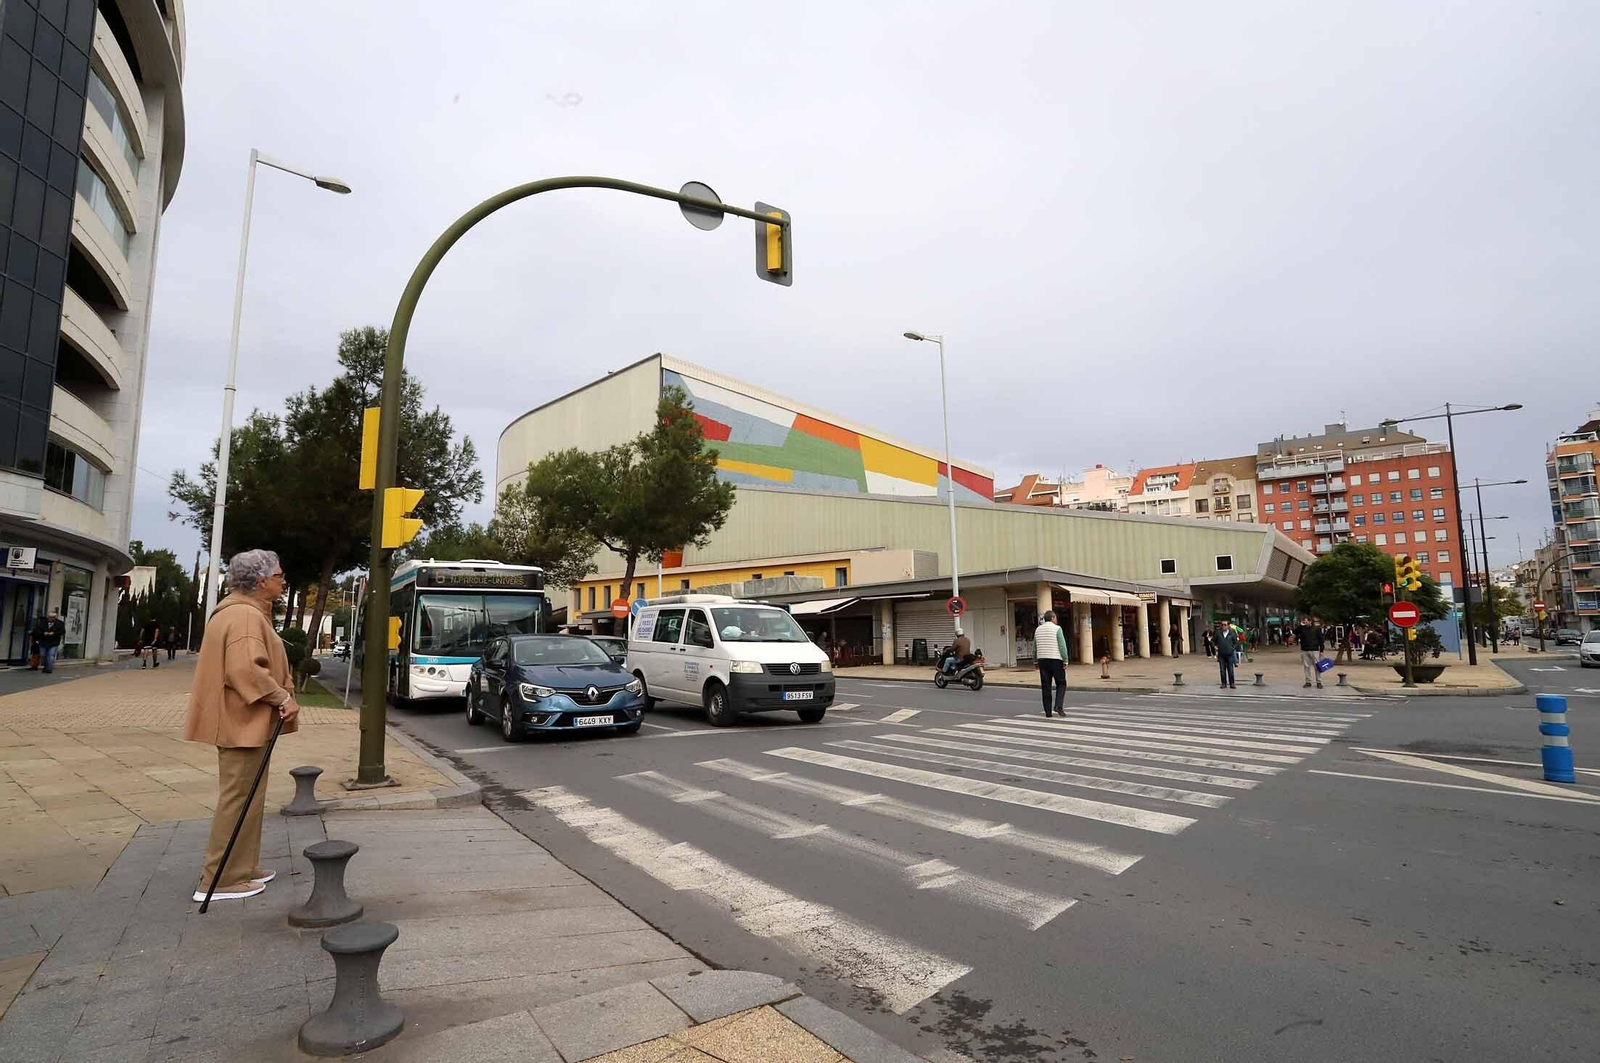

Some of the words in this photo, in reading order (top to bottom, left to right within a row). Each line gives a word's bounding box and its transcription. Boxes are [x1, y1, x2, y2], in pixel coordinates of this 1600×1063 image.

[786, 692, 801, 700] 9513
[578, 717, 596, 726] 6449
[598, 716, 612, 724] KXY
